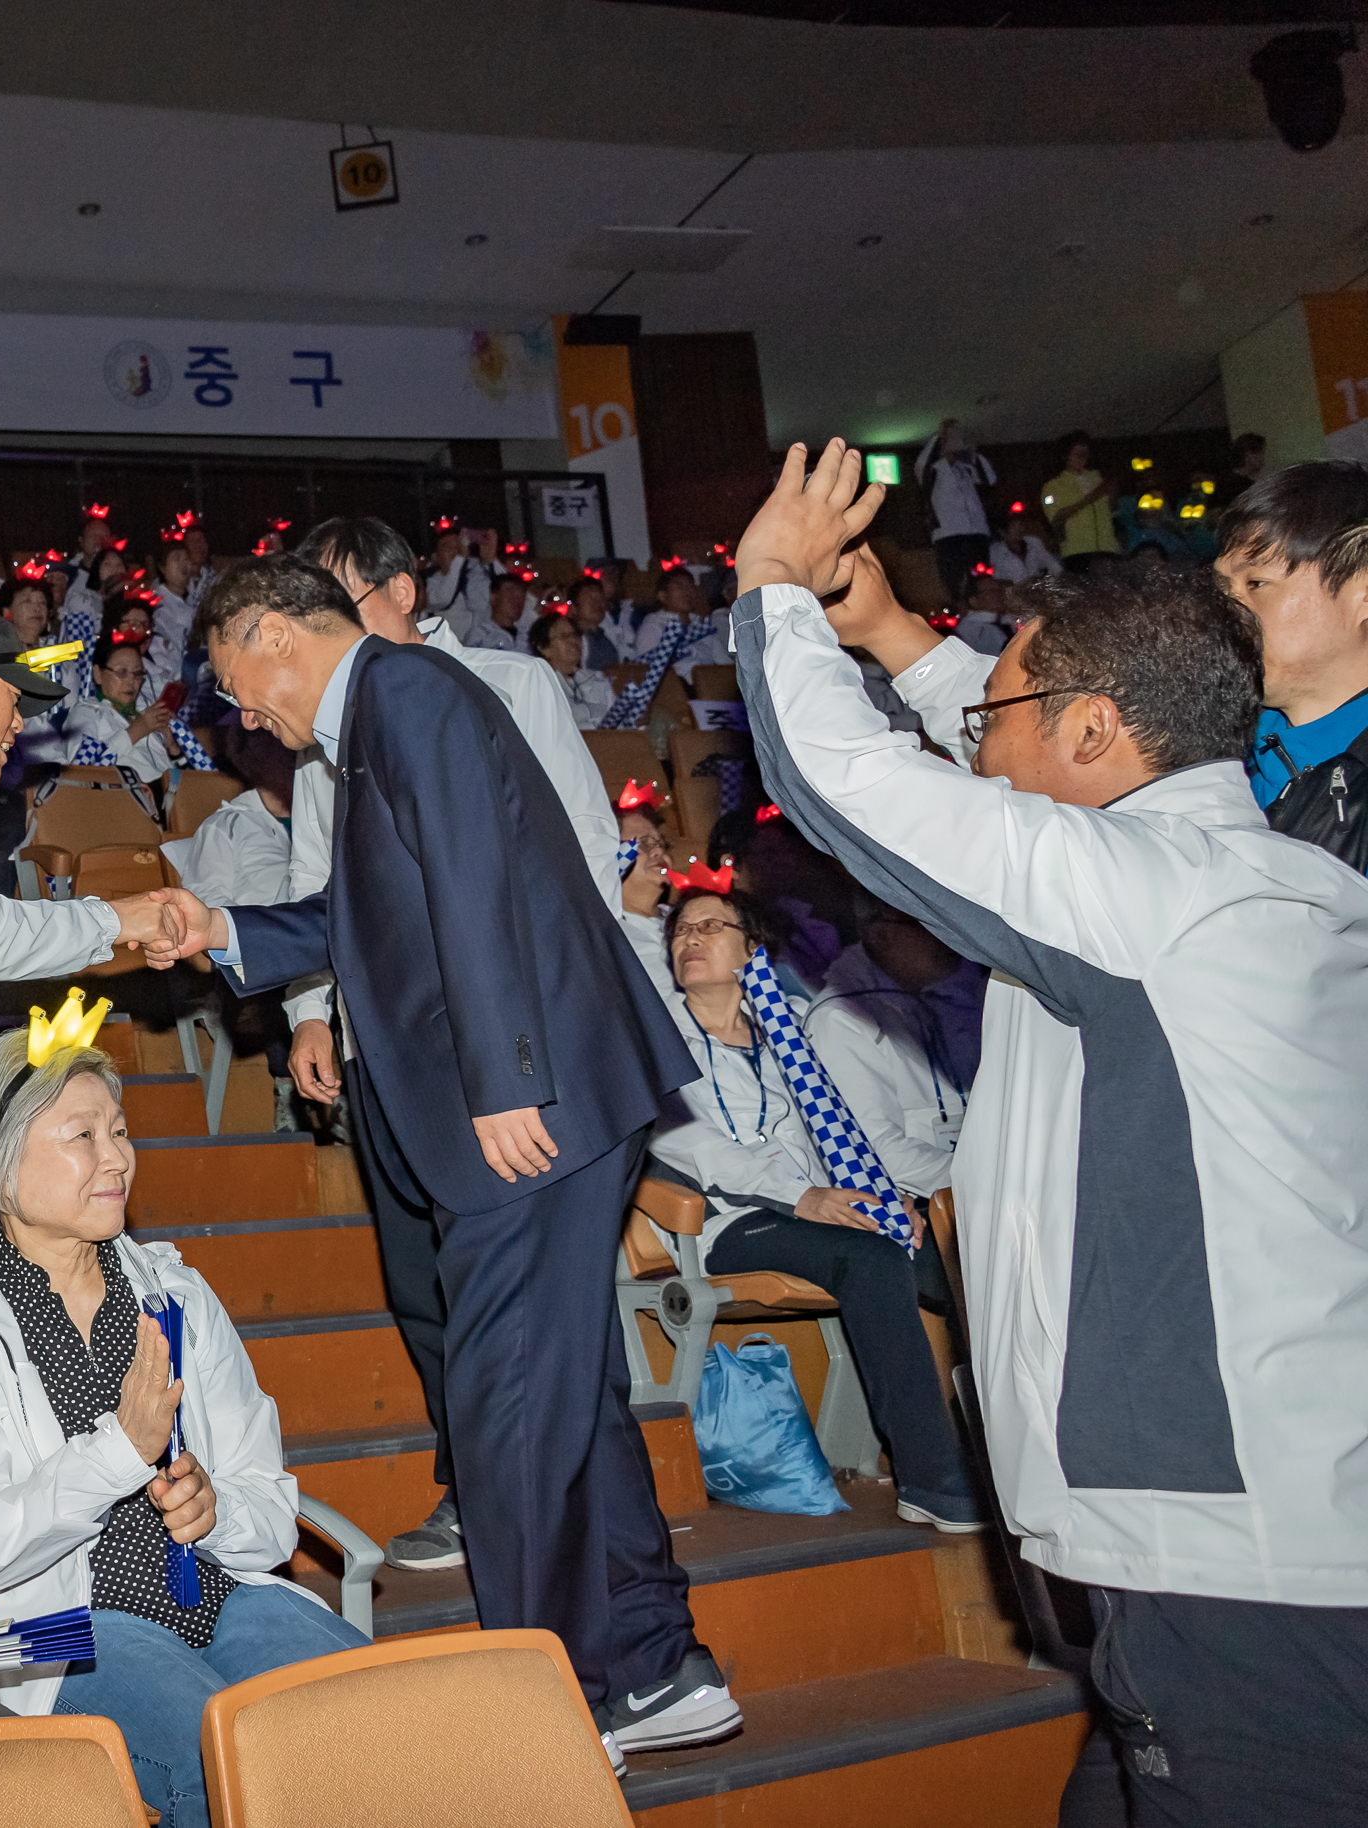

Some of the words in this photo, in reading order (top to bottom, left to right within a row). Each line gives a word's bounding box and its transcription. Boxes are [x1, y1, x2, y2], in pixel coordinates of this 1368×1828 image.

[348, 163, 382, 187] 10
[569, 402, 631, 450] 10
[548, 495, 589, 517] 중구
